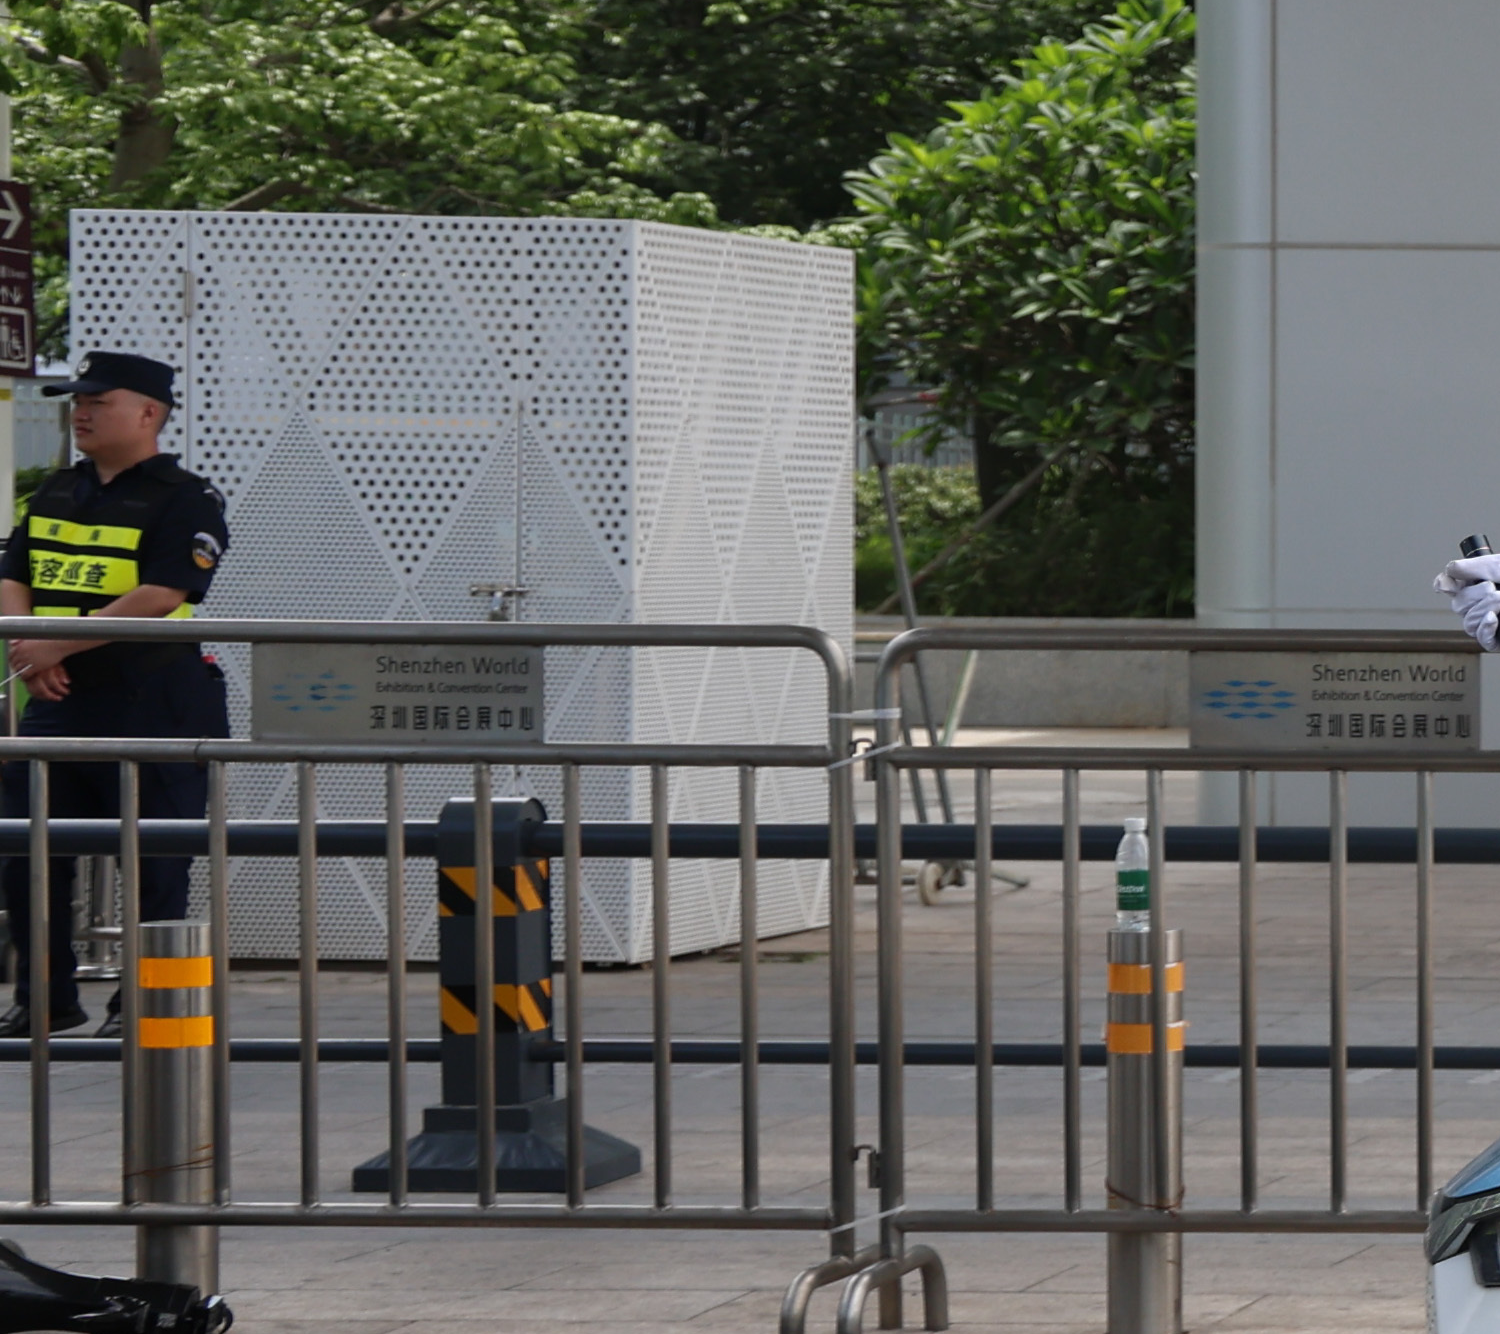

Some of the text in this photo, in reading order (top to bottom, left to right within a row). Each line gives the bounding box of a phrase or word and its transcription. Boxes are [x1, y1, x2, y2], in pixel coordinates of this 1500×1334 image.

[376, 656, 530, 675] Shenzhen World
[1312, 664, 1466, 683] Shenzhen World
[376, 682, 425, 693] Exhibition
[437, 682, 493, 694] Convention
[495, 683, 528, 694] Center
[1312, 690, 1360, 701] Exhibition
[1373, 690, 1429, 702] Convention
[1432, 691, 1465, 702] Center
[370, 705, 534, 731] 深圳国际会展中心
[1306, 714, 1470, 739] 深圳国际会展中心
